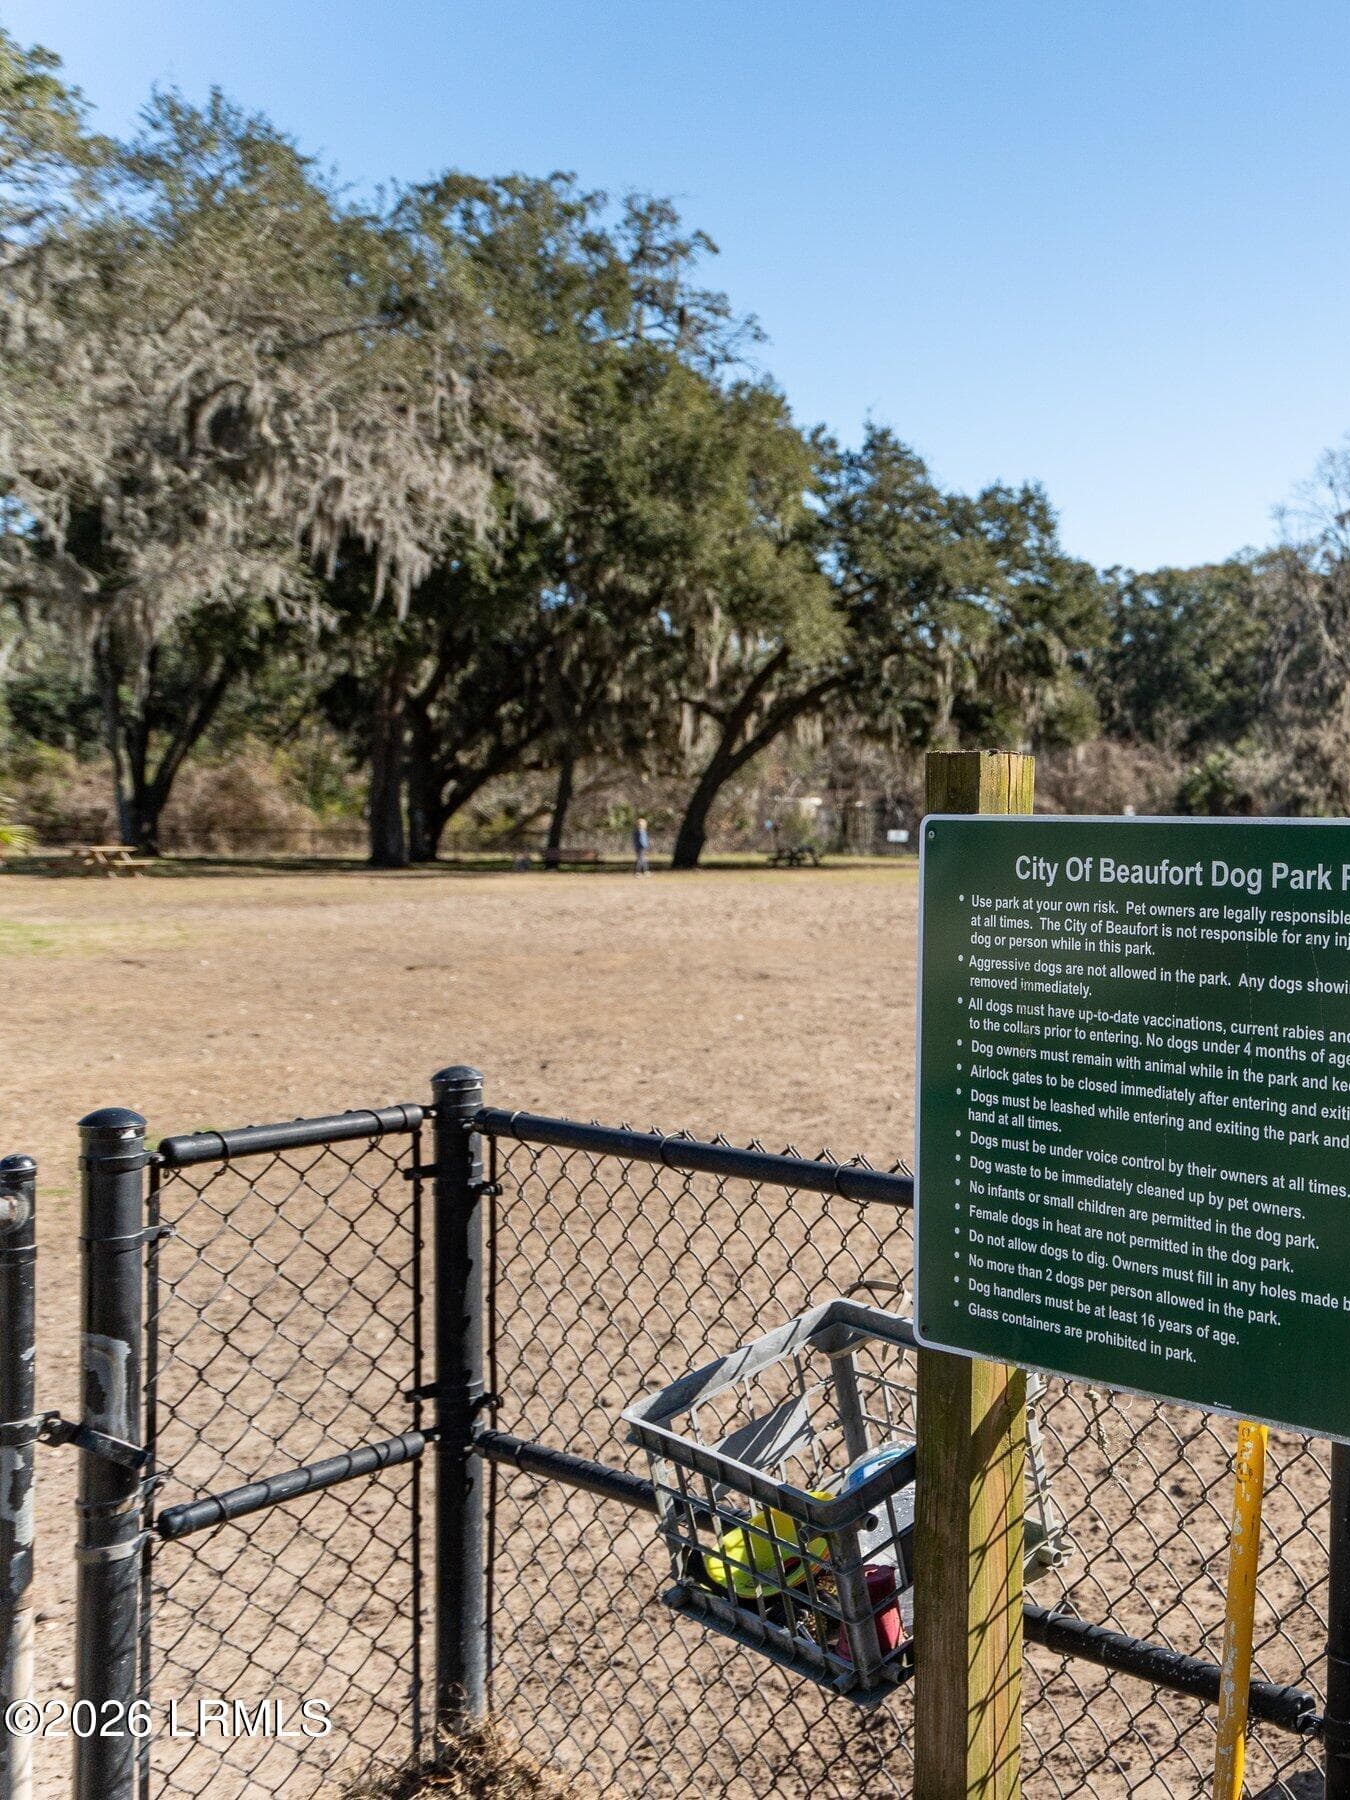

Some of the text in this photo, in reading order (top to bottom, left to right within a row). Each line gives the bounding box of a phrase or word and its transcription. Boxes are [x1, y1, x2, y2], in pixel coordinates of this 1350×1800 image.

[1015, 855, 1059, 888] City
[1065, 856, 1094, 882] Of
[1099, 857, 1204, 887] Beaufort
[1211, 860, 1262, 895] Dog
[1271, 862, 1333, 891] Park
[971, 894, 993, 908] Use
[995, 895, 1020, 912] park
[1022, 897, 1034, 910] at
[1035, 900, 1063, 914] your
[1065, 901, 1090, 913] own
[1093, 899, 1119, 914] risk.
[1126, 900, 1147, 916] Pet
[1149, 905, 1196, 918] owners
[1198, 907, 1220, 919] are
[1223, 904, 1267, 925] legally
[970, 931, 1155, 958] dog or person while in this park.
[970, 976, 1092, 998] removed immediately.
[967, 997, 983, 1011] All
[985, 998, 1013, 1016] dogs
[1016, 1003, 1045, 1017] must
[1047, 1003, 1076, 1019] have
[1078, 1008, 1140, 1025] up-to-date
[1142, 1014, 1227, 1036] vaccinations,
[1230, 1022, 1279, 1038] current
[1282, 1024, 1325, 1042] rabies
[969, 1016, 981, 1030] to
[982, 1017, 1001, 1032] the
[1003, 1020, 1041, 1036] collars
[1043, 1024, 1073, 1040] prior
[1074, 1026, 1087, 1041] to
[1089, 1029, 1143, 1049] entering.
[1146, 1032, 1164, 1048] No
[1166, 1034, 1199, 1054] dogs
[1202, 1039, 1241, 1055] under
[1243, 1041, 1252, 1056] 4
[1255, 1045, 1307, 1062] months
[1310, 1048, 1326, 1063] of
[967, 1107, 1062, 1133] hand at all times.
[970, 1088, 999, 1107] Dogs
[1001, 1095, 1031, 1109] must
[1032, 1096, 1048, 1111] be
[1050, 1098, 1096, 1117] leashed
[1097, 1105, 1131, 1122] while
[1133, 1110, 1185, 1132] entering
[1187, 1117, 1212, 1132] and
[1215, 1120, 1260, 1141] exiting
[1263, 1124, 1285, 1141] the
[1288, 1130, 1320, 1146] park
[1323, 1134, 1350, 1149] and
[970, 1130, 1350, 1199] Dogs must be under voice control by their owners at all times.
[969, 1179, 1320, 1250] No infants or small children are permitted in the dog park.
[969, 1204, 1294, 1274] Female dogs in heat are not permitted in the dog park.
[968, 1228, 985, 1244] Do
[987, 1235, 1006, 1248] not
[1007, 1236, 1038, 1254] allow
[1039, 1242, 1069, 1262] dogs
[1071, 1248, 1084, 1262] to
[1086, 1250, 1109, 1270] dig.
[1111, 1254, 1159, 1276] Owners
[1162, 1266, 1194, 1283] must
[1196, 1269, 1213, 1286] fill
[1216, 1272, 1229, 1289] in
[1232, 1279, 1257, 1297] any
[1260, 1280, 1297, 1302] holes
[1300, 1291, 1339, 1309] made
[968, 1253, 1281, 1326] No more than 2 dogs per person allowed in the park.
[968, 1302, 1197, 1364] Glass containers are prohibited in park.
